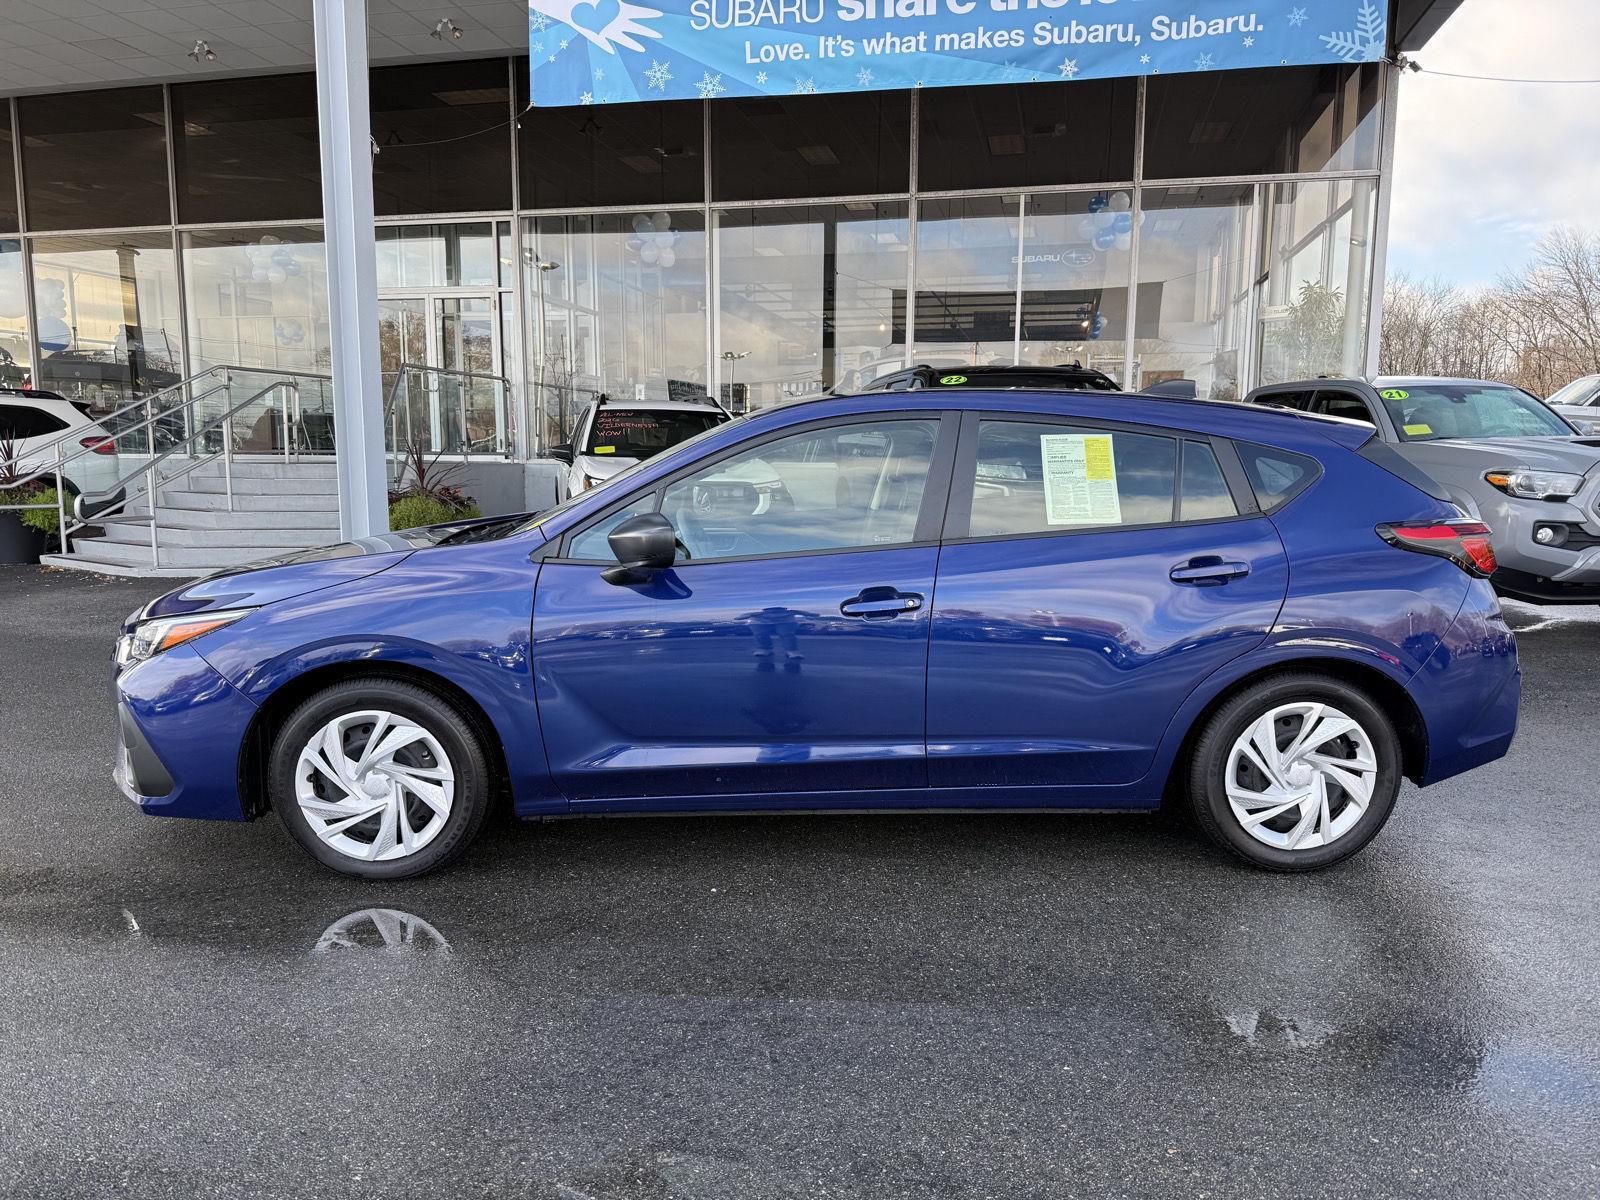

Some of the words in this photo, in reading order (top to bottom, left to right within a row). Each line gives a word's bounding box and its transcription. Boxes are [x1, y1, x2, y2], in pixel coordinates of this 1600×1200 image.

[690, 0, 824, 30] SUBARU
[744, 40, 810, 64] Love.
[862, 31, 927, 55] what
[935, 26, 1025, 51] makes
[1033, 20, 1141, 46] Subaru,
[1150, 13, 1264, 41] Subaru.
[1011, 254, 1060, 264] SUBARU
[1385, 390, 1402, 398] 21
